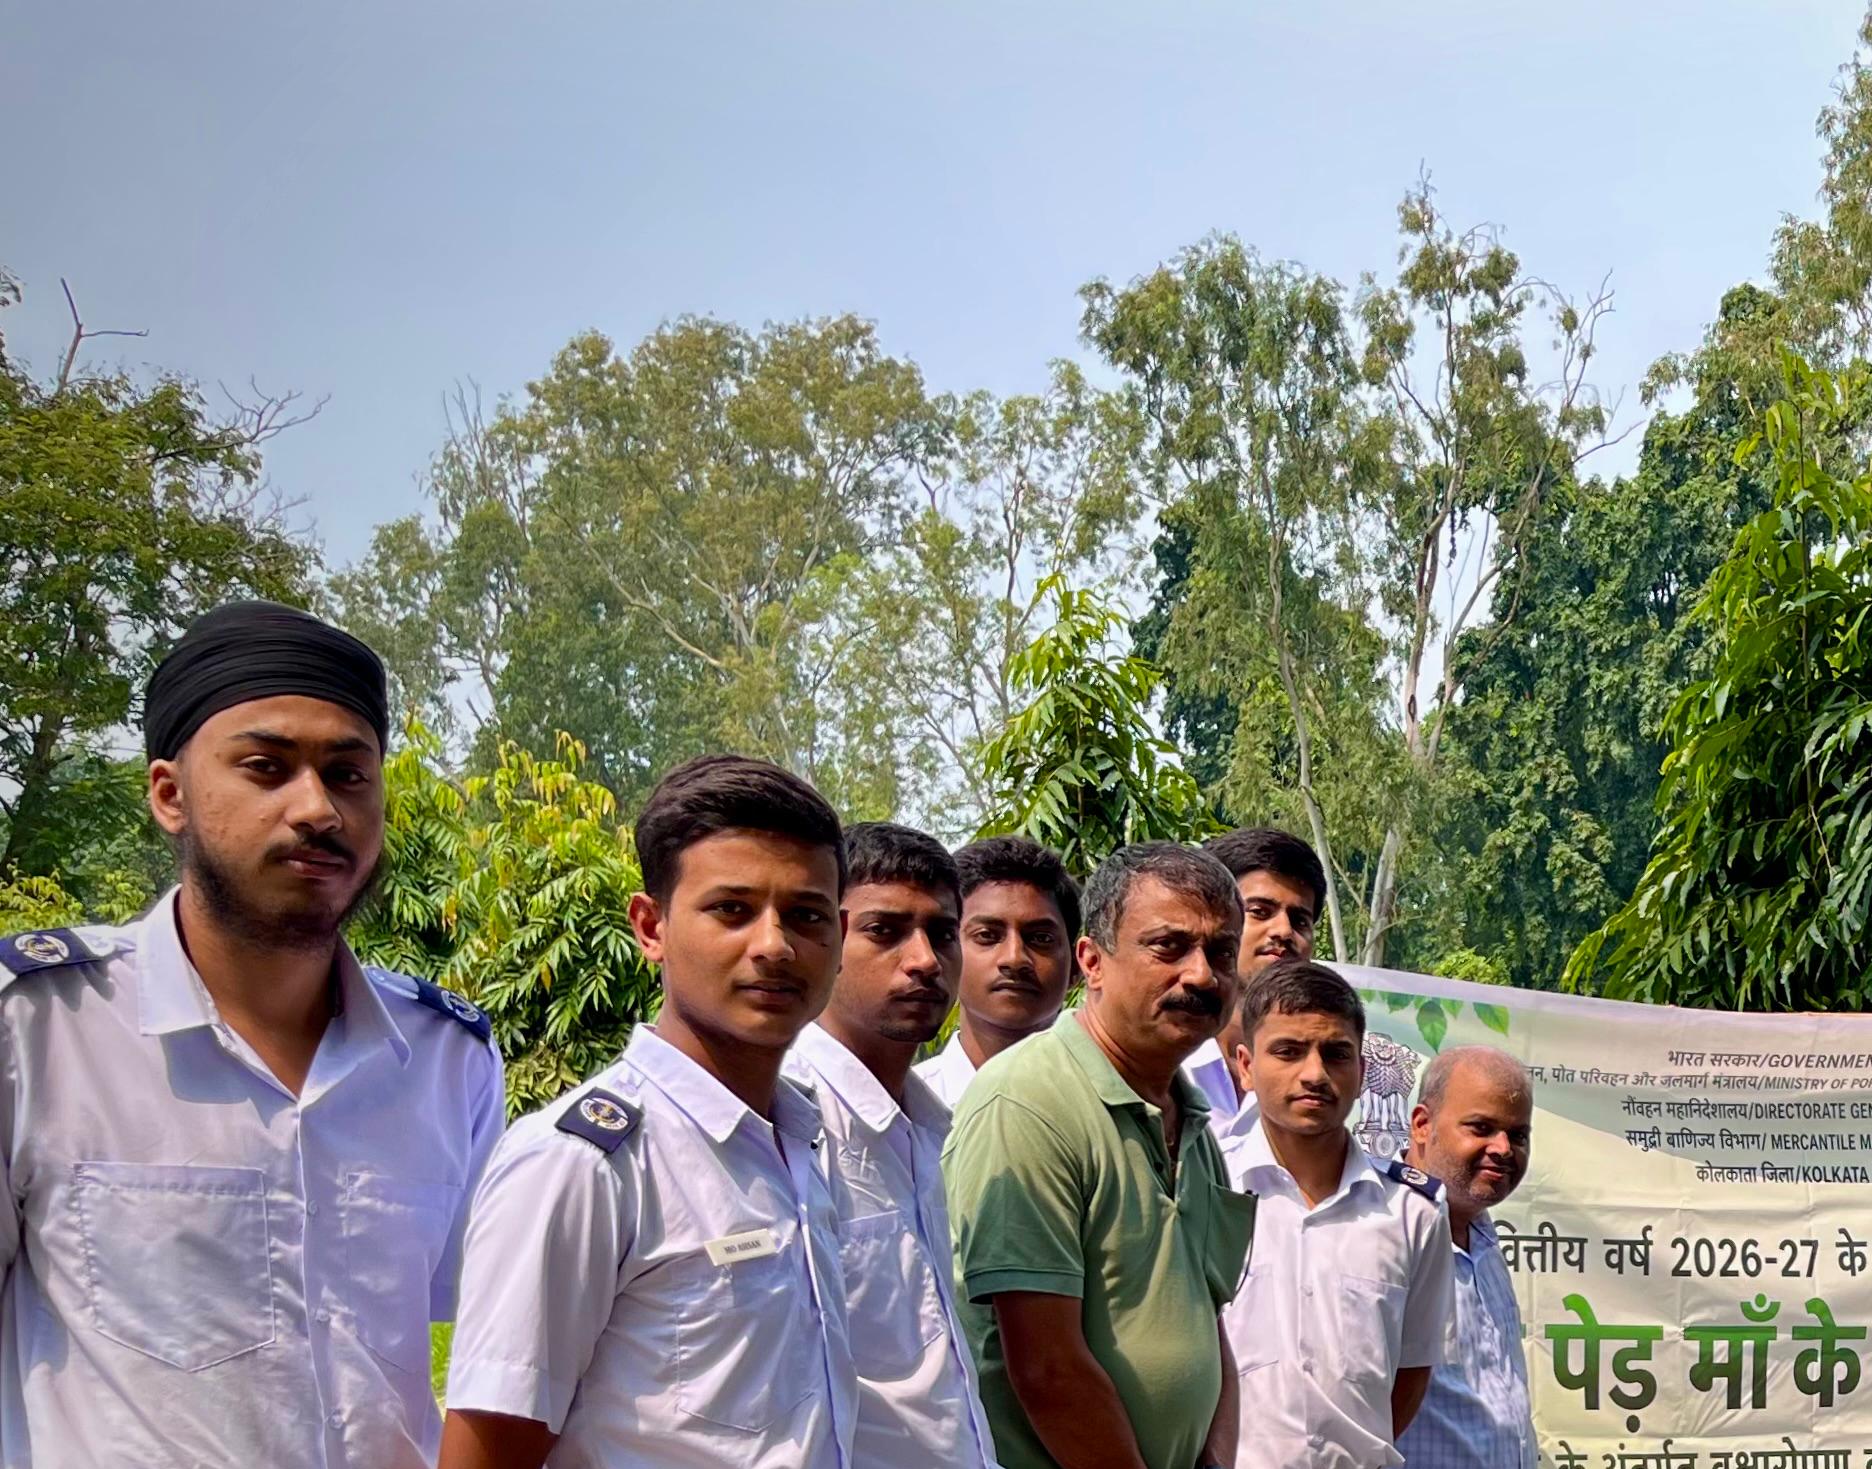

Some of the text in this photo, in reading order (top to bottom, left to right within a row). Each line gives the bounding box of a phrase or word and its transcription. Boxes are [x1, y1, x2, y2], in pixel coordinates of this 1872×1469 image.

[1668, 1050, 1703, 1067] भारत
[1552, 1064, 1576, 1083] पोत
[1580, 1067, 1627, 1086] परिवहन
[1631, 1072, 1655, 1087] और
[1660, 1071, 1708, 1088] जलमार्ग
[1831, 1078, 1848, 1089] OF
[1625, 1126, 1661, 1152] समुद्री
[1771, 1133, 1856, 1151] MERCANTILE
[1695, 1160, 1756, 1183] कोलकाता
[1761, 1161, 1869, 1184] जिला/KOLKATA
[1603, 1225, 1653, 1276] वर्ष
[1671, 1236, 1819, 1278] 2026-27
[1835, 1227, 1868, 1276] के
[1544, 1293, 1664, 1433] पेड़
[1683, 1293, 1781, 1410] माँ
[1792, 1298, 1868, 1408] के
